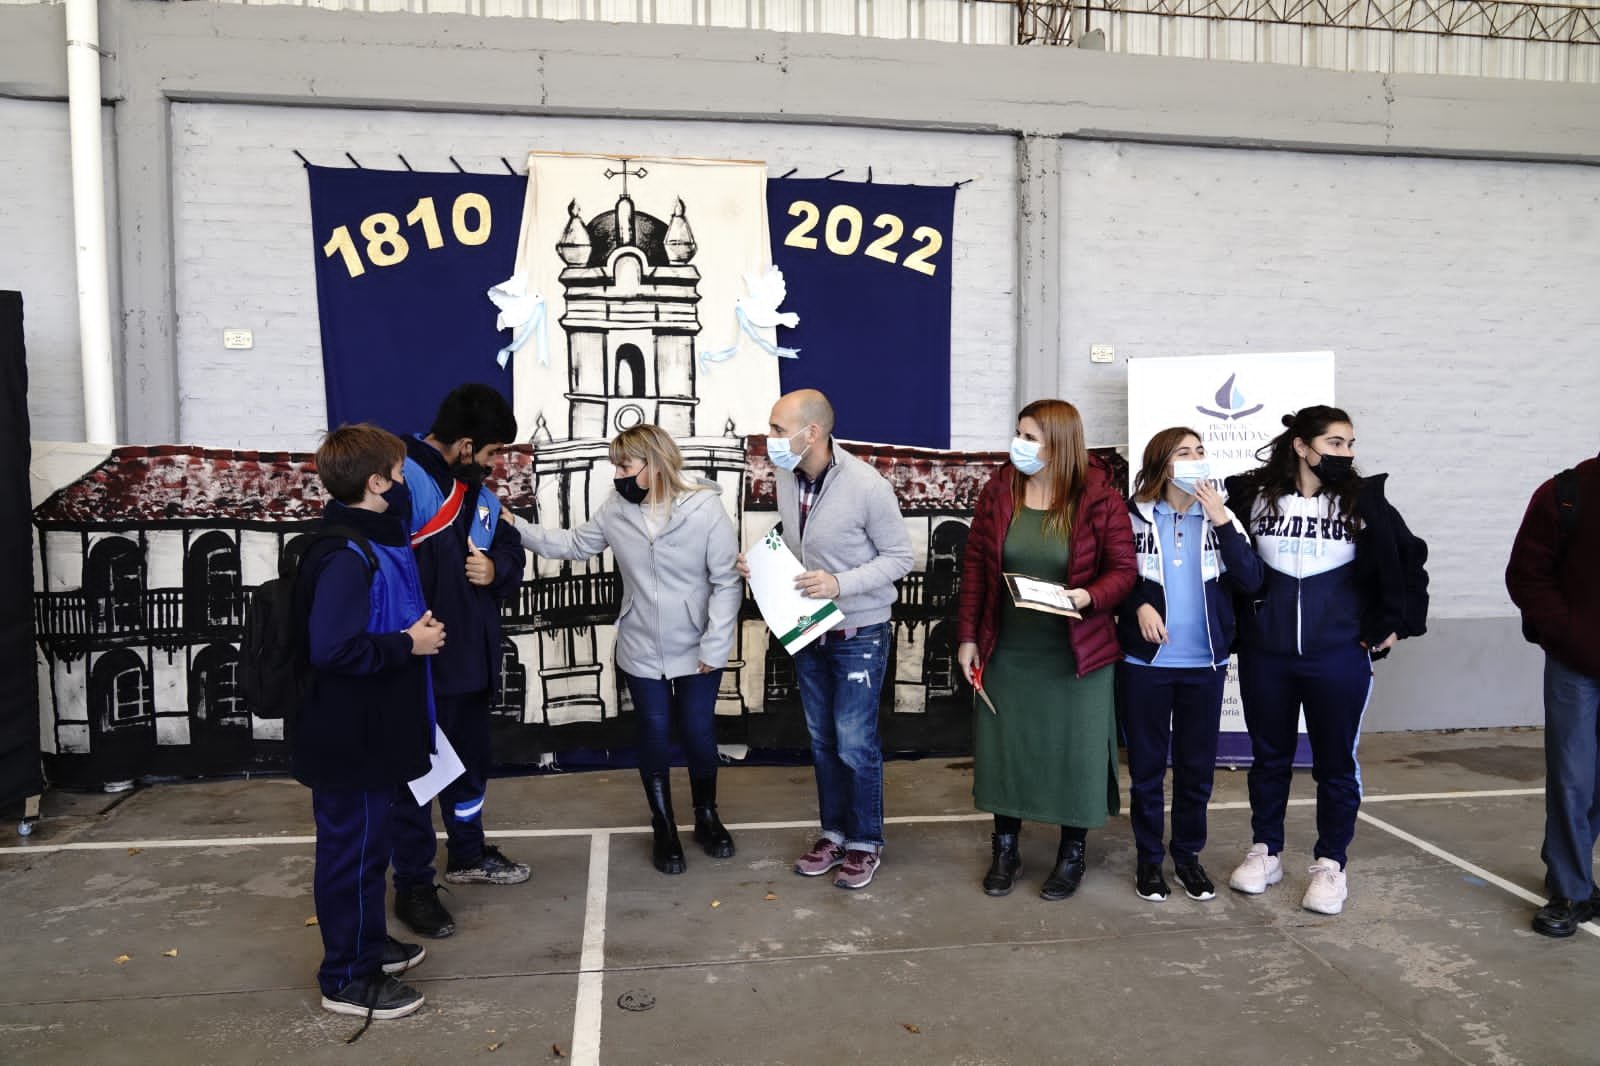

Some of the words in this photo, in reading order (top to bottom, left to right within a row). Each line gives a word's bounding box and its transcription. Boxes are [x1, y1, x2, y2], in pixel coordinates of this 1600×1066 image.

[323, 192, 492, 278] 1810
[784, 200, 943, 276] 2022
[1199, 431, 1271, 442] LIMPIADAS
[1211, 448, 1267, 459] SENDERS
